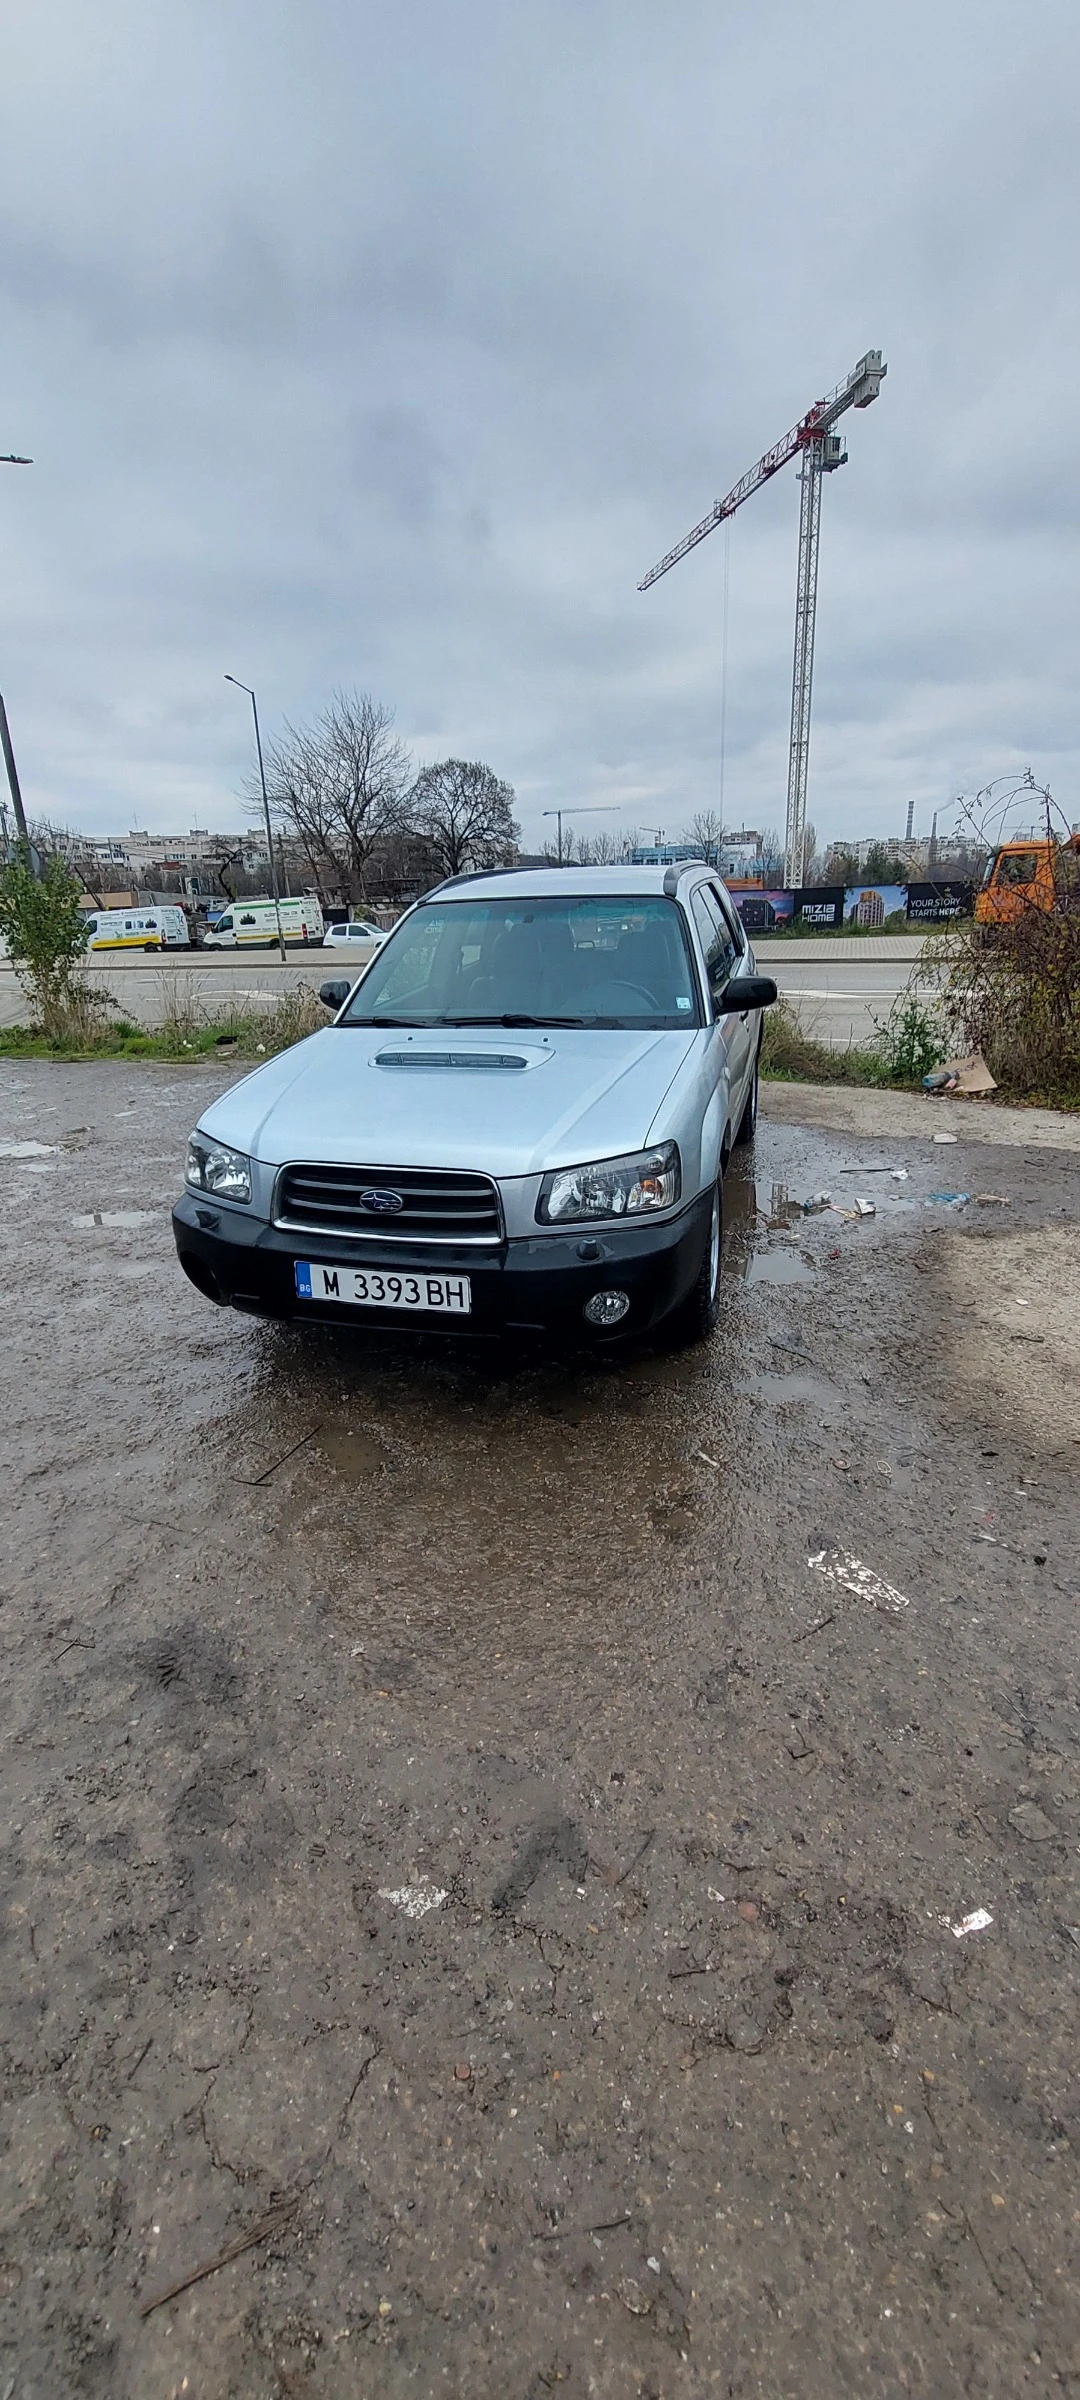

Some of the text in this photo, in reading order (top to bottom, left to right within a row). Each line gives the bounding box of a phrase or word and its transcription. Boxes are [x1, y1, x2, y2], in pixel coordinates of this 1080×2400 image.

[910, 897, 961, 907] YOUR STORY
[802, 903, 835, 914] MIZIA
[910, 908, 938, 917] STARTS
[801, 913, 835, 922] HOME
[299, 1283, 311, 1293] BG
[322, 1269, 340, 1297] M
